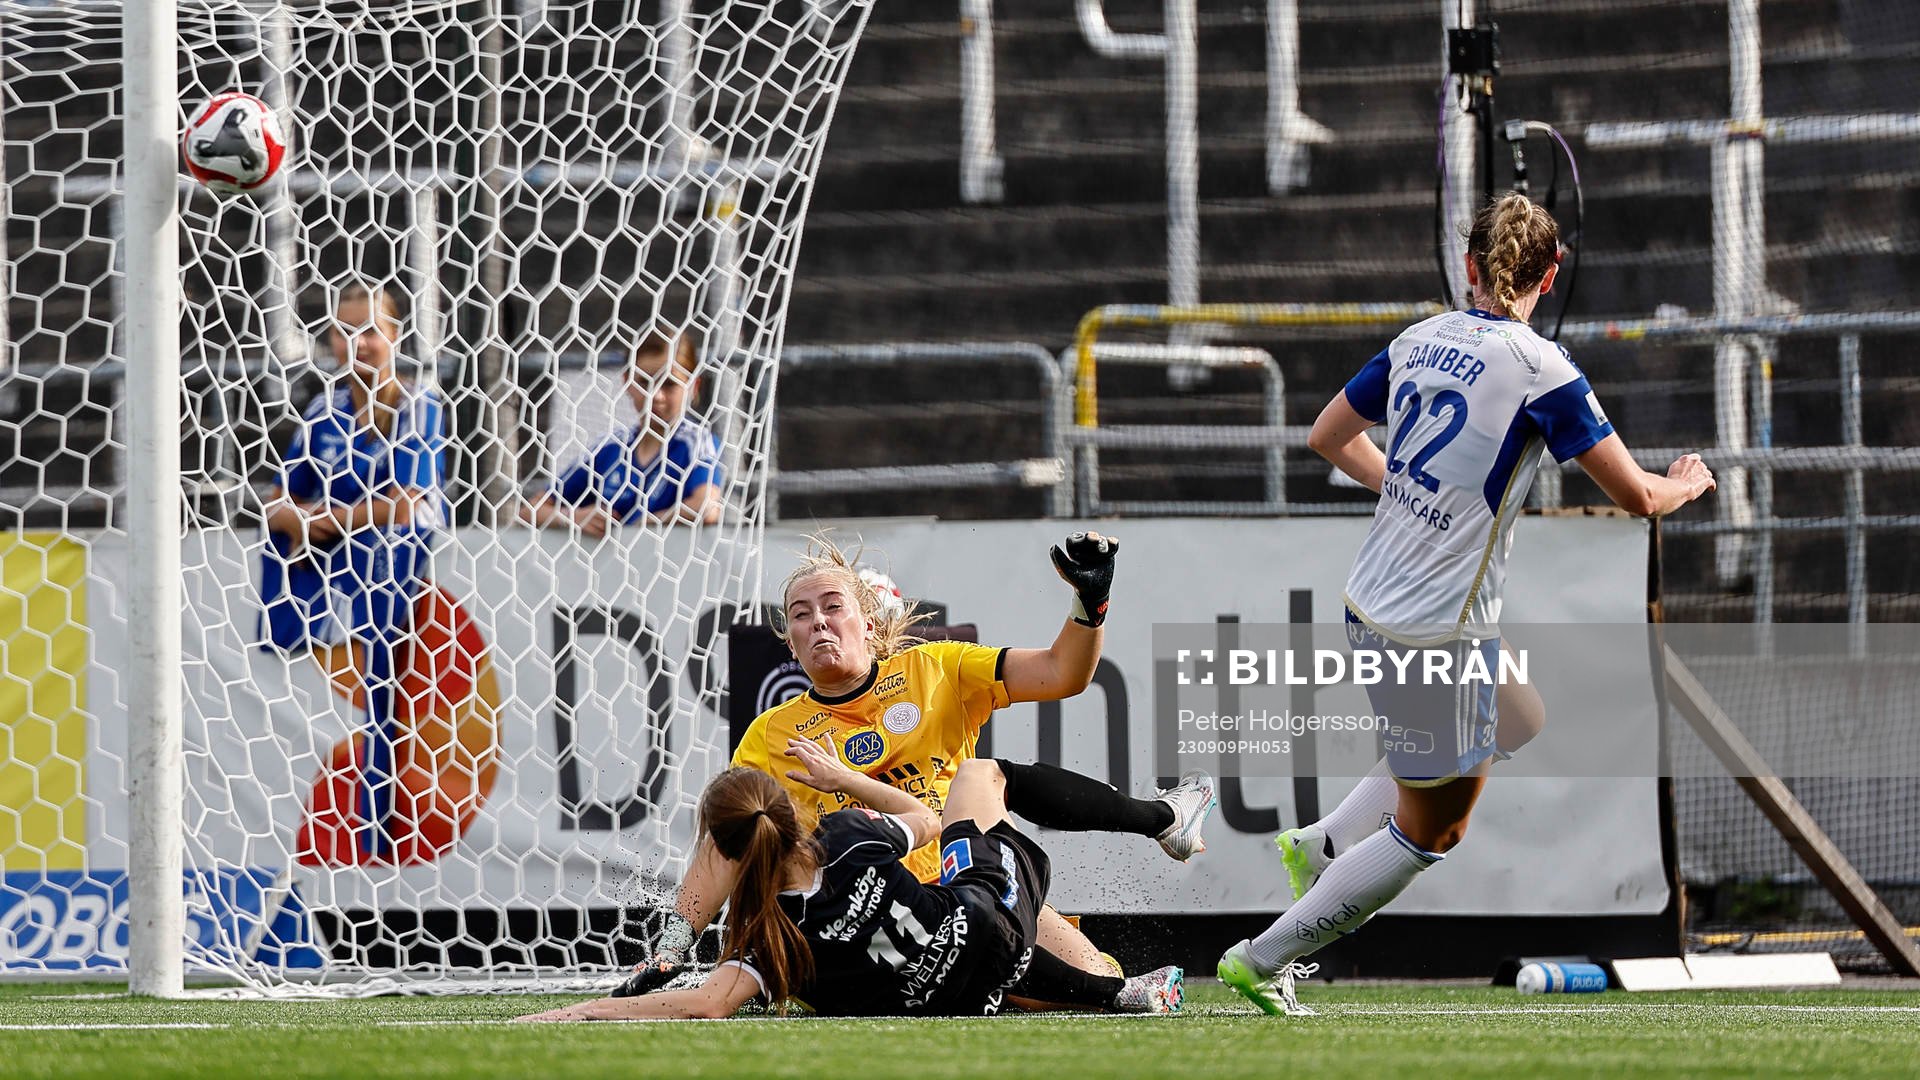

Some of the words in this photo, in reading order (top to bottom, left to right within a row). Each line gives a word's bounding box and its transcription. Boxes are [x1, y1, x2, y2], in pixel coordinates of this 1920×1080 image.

[1406, 344, 1486, 386] DAWBER
[1433, 331, 1482, 347] Norrköping
[1387, 381, 1468, 494] 22
[848, 733, 881, 759] HSB
[819, 866, 877, 940] Hemköp
[1316, 902, 1361, 932] Ocab
[868, 900, 934, 973] 11
[900, 915, 952, 996] WELLNESS
